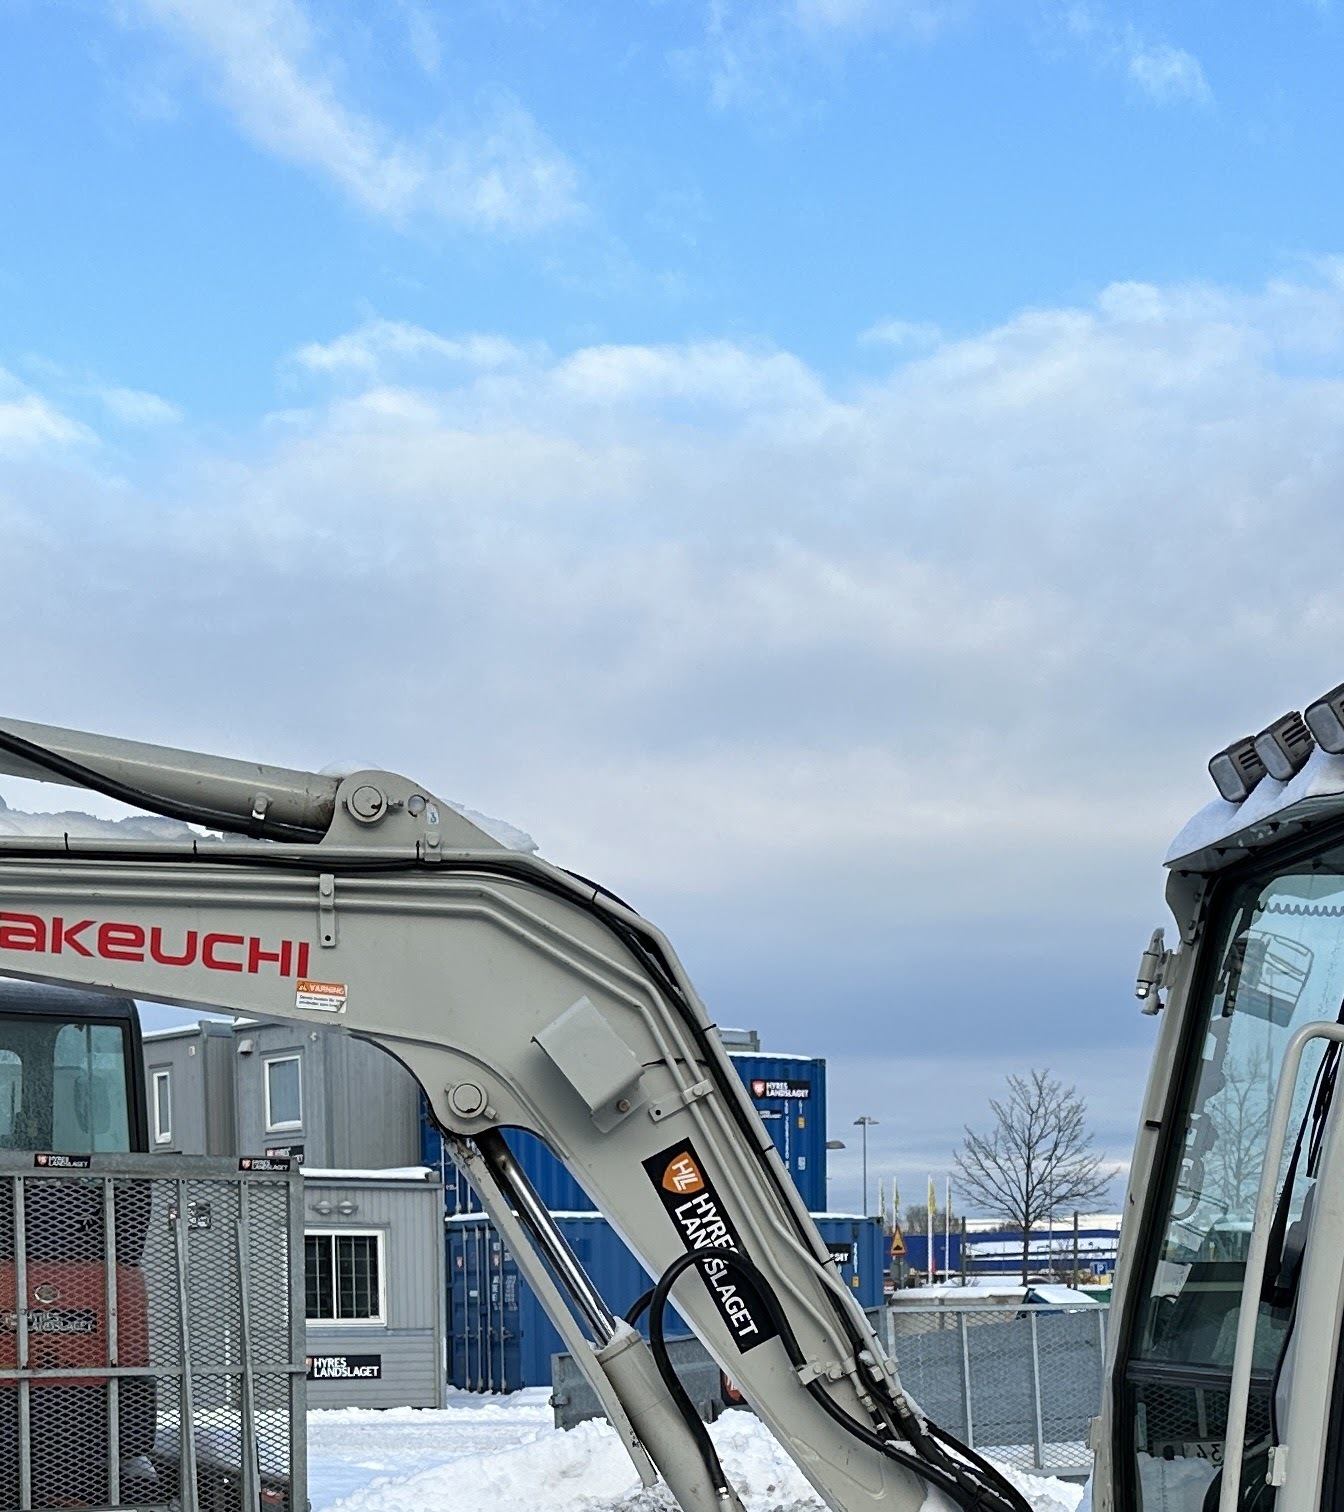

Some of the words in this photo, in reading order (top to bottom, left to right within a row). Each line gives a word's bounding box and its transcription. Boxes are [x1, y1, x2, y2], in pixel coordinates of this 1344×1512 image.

[675, 1201, 759, 1337] LANSLAGET
[313, 1357, 347, 1368] HYRES
[313, 1366, 380, 1378] LANDSLAGET
